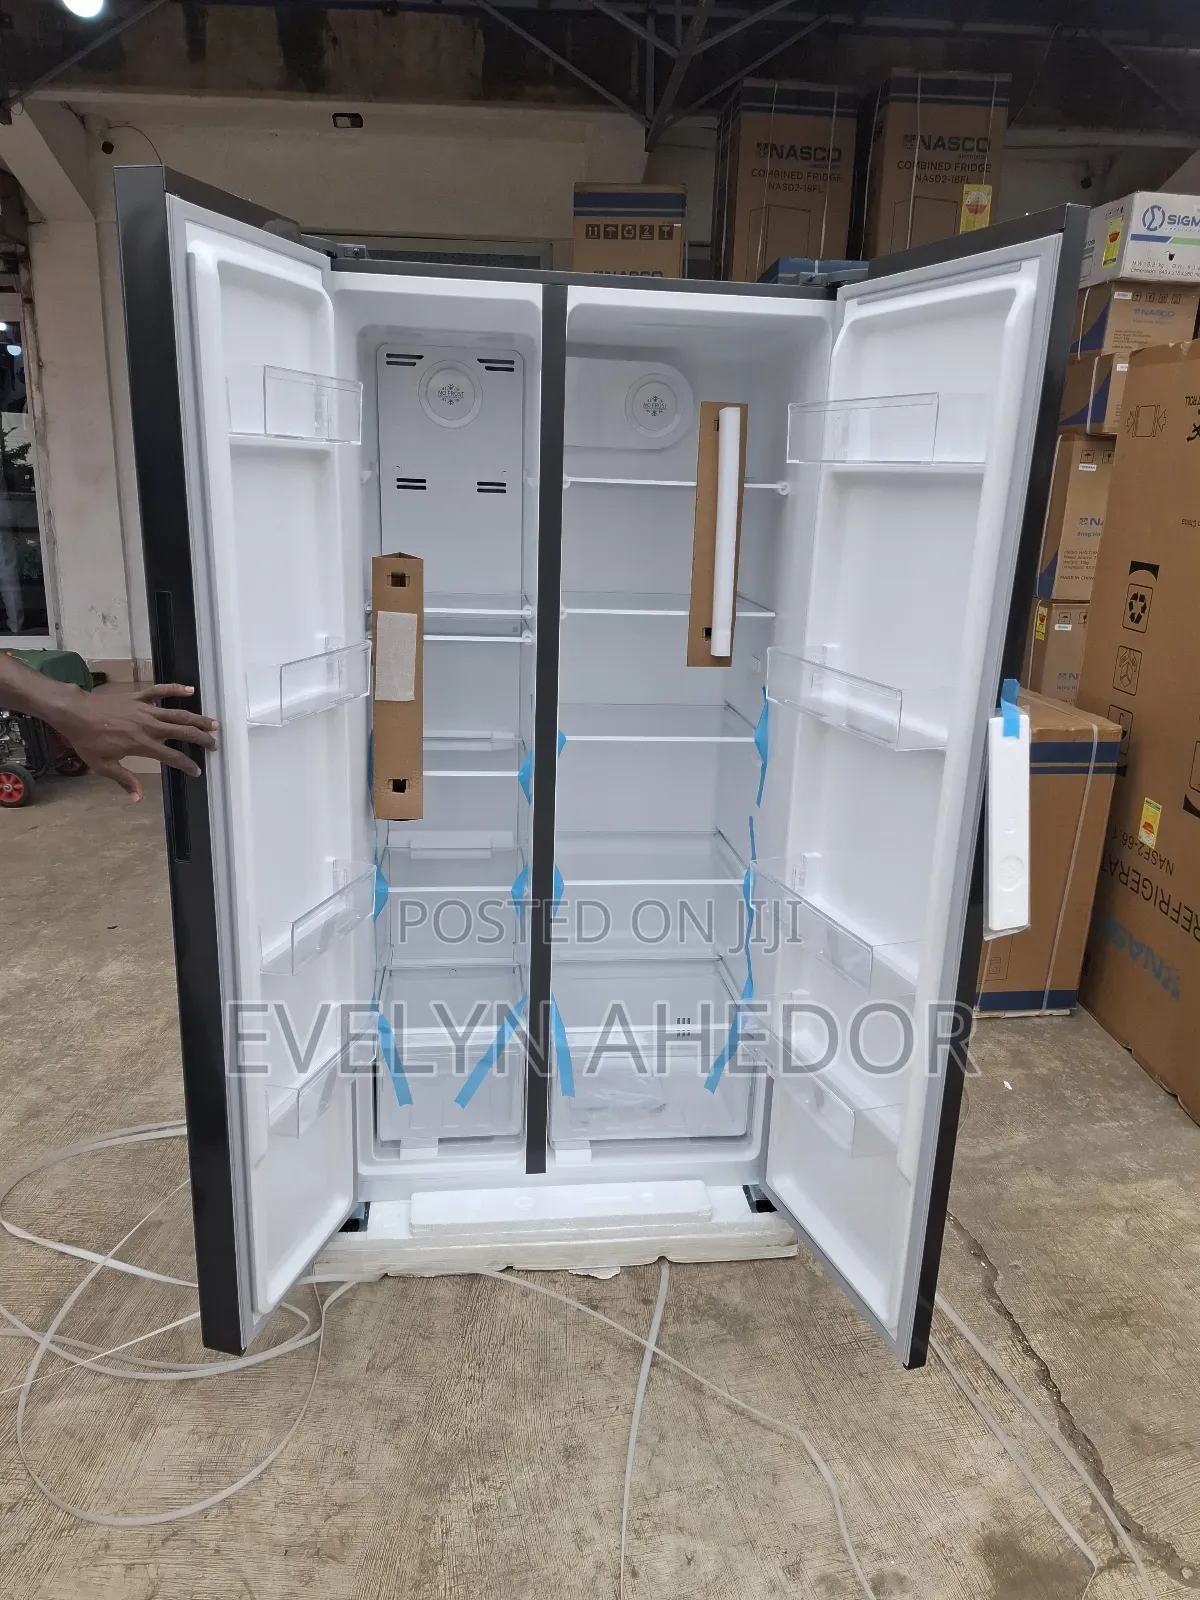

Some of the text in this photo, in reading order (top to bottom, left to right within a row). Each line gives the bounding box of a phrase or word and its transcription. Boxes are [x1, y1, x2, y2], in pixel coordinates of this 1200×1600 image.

[919, 134, 991, 153] NASCO
[769, 143, 842, 162] NASCO
[897, 160, 992, 173] COMBINED FRIDGE
[751, 168, 843, 182] COMBINED FRIDGE
